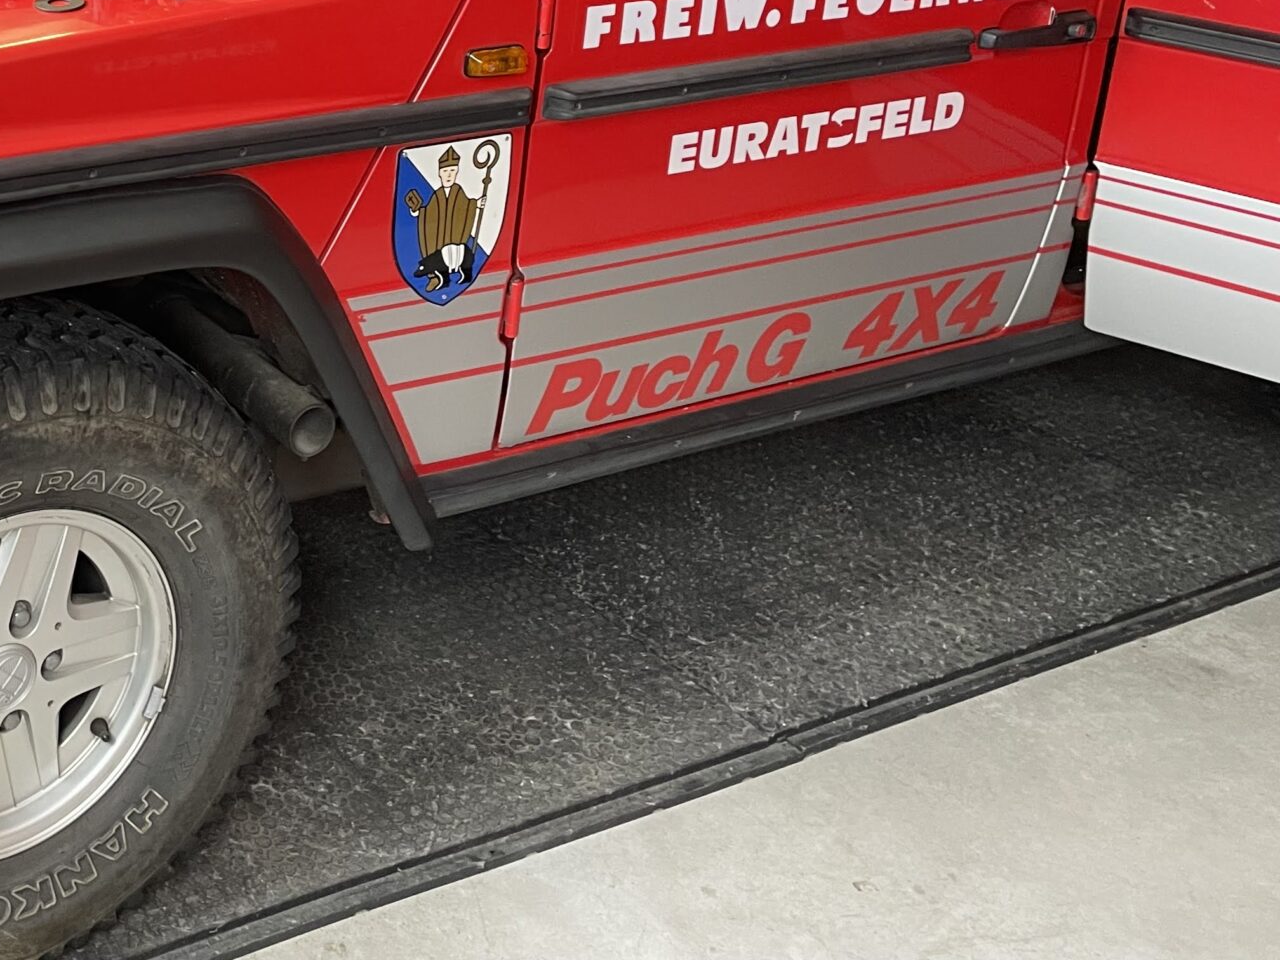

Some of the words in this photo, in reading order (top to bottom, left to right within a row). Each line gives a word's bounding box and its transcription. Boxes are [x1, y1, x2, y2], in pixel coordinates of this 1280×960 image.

[667, 91, 965, 175] EURATSFELD
[524, 329, 740, 436] Puch
[744, 312, 812, 385] G
[842, 270, 1006, 358] 4X4
[34, 469, 204, 553] RADIAL
